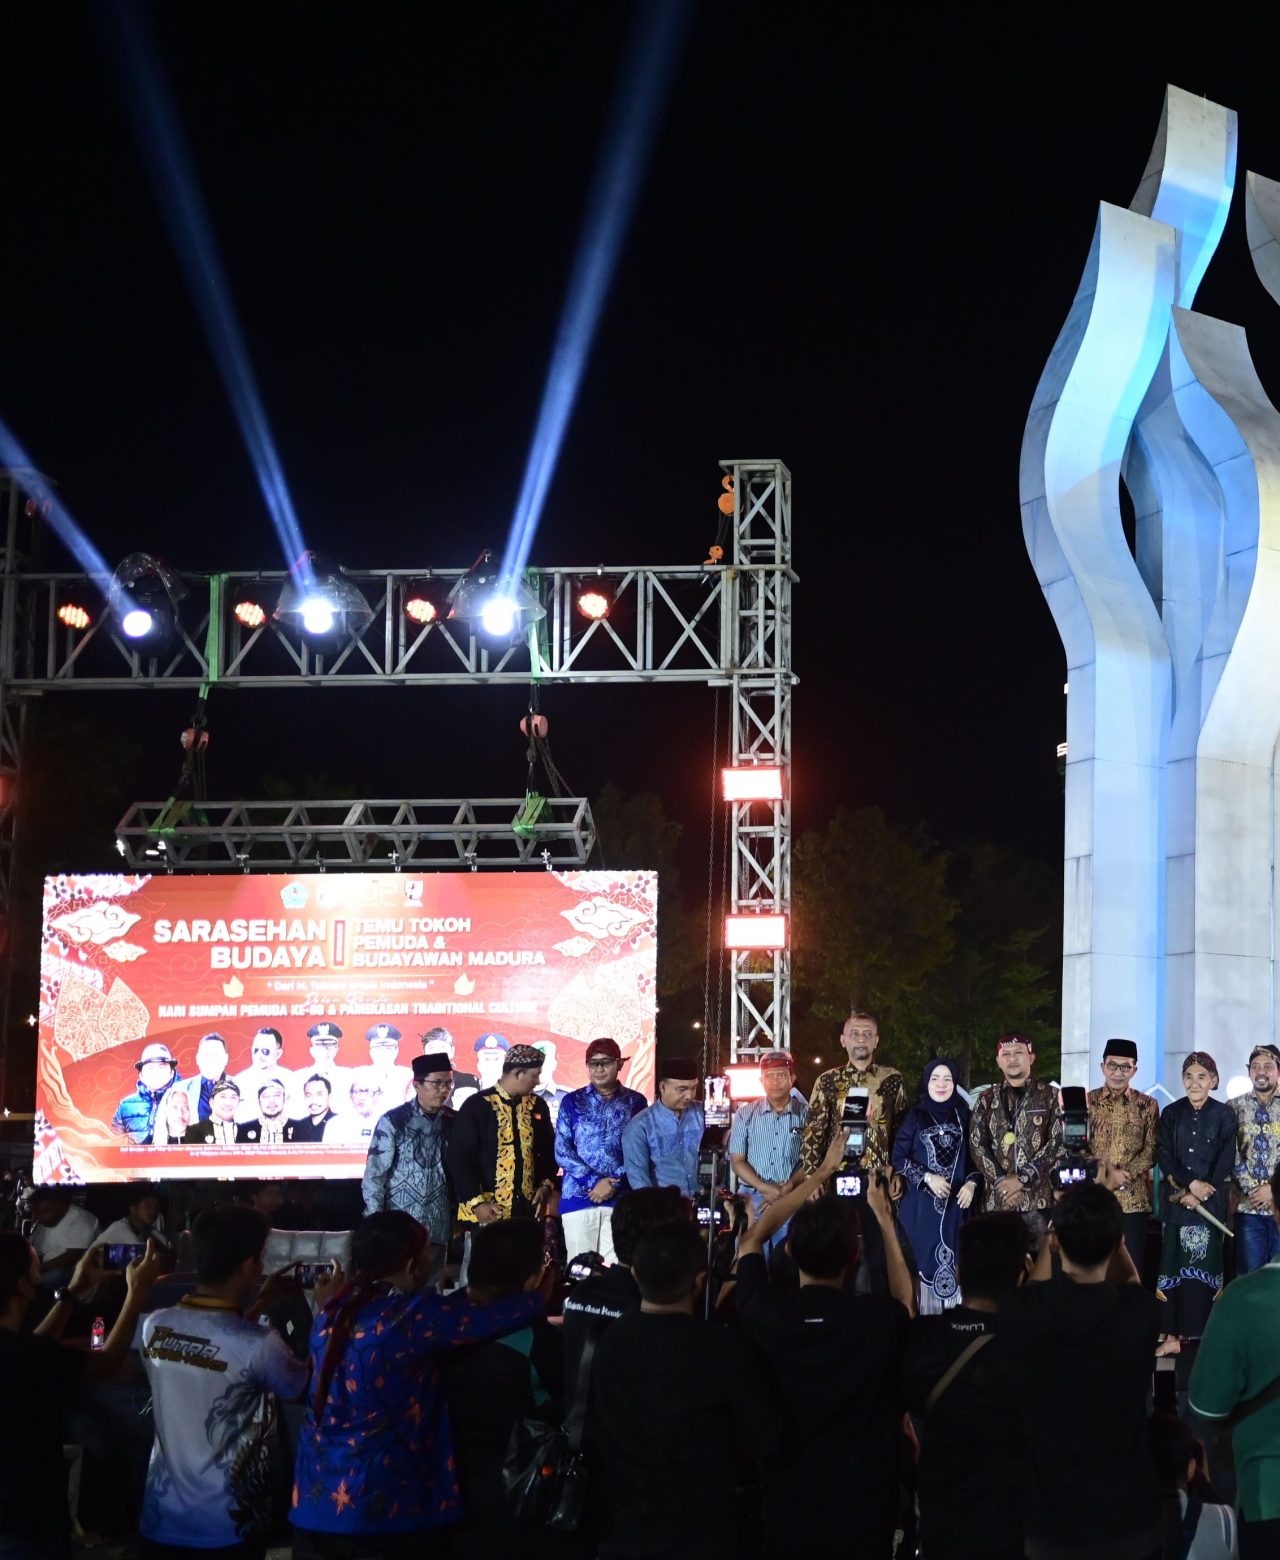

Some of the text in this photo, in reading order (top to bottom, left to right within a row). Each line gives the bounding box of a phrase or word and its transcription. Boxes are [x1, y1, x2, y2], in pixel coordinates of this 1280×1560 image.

[153, 918, 327, 944] SARASEHAN
[354, 916, 472, 933] TEMU TOKOH
[353, 935, 446, 950] PEMUDA &
[210, 945, 327, 969] BUDAYA
[352, 950, 546, 967] BUDAYAWAN MADURA
